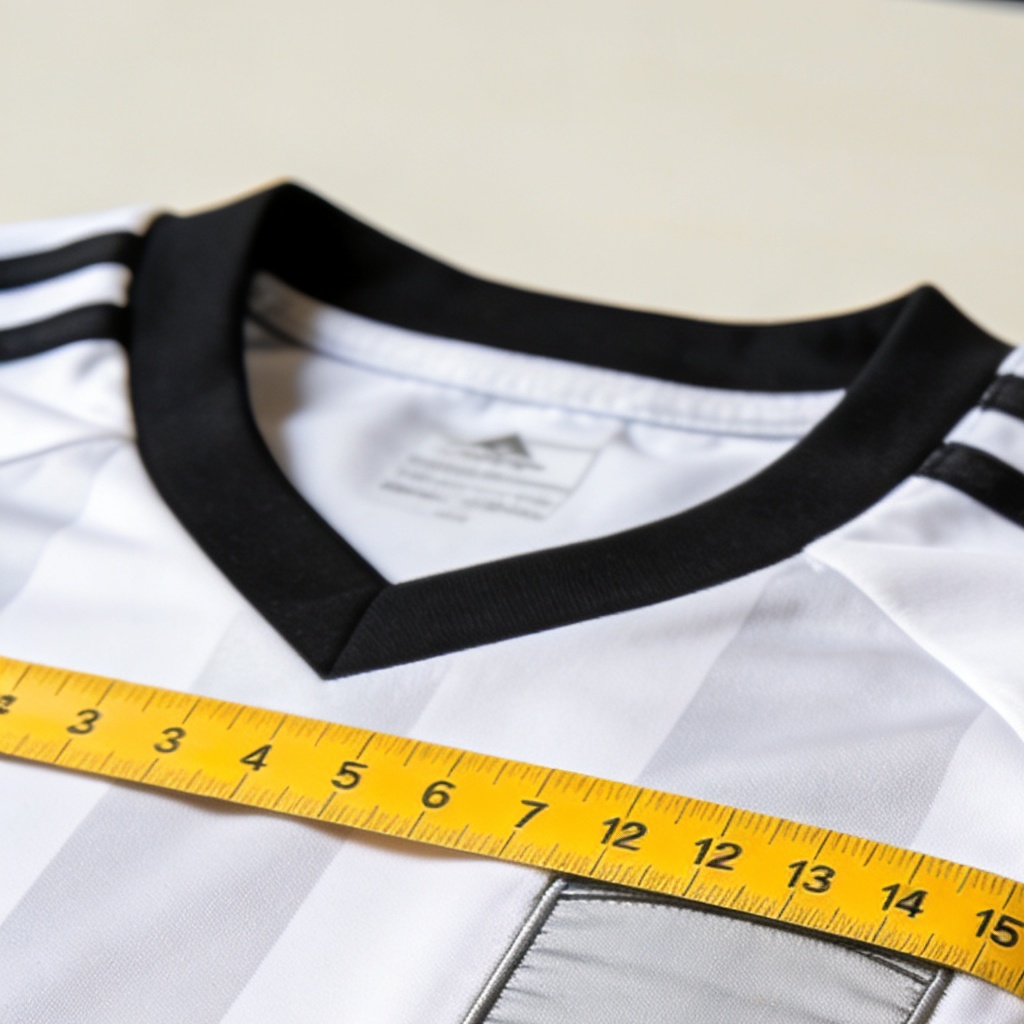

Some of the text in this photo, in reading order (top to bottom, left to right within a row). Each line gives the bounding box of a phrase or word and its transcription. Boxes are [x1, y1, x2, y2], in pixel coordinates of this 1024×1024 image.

[67, 709, 102, 734] 3
[154, 727, 186, 753] 3
[240, 744, 273, 771] 4
[331, 761, 368, 790] 5
[421, 780, 456, 809] 6
[514, 799, 549, 828] 7
[601, 817, 648, 851] 12
[694, 838, 743, 871] 12
[786, 860, 836, 893] 13
[881, 883, 929, 918] 14
